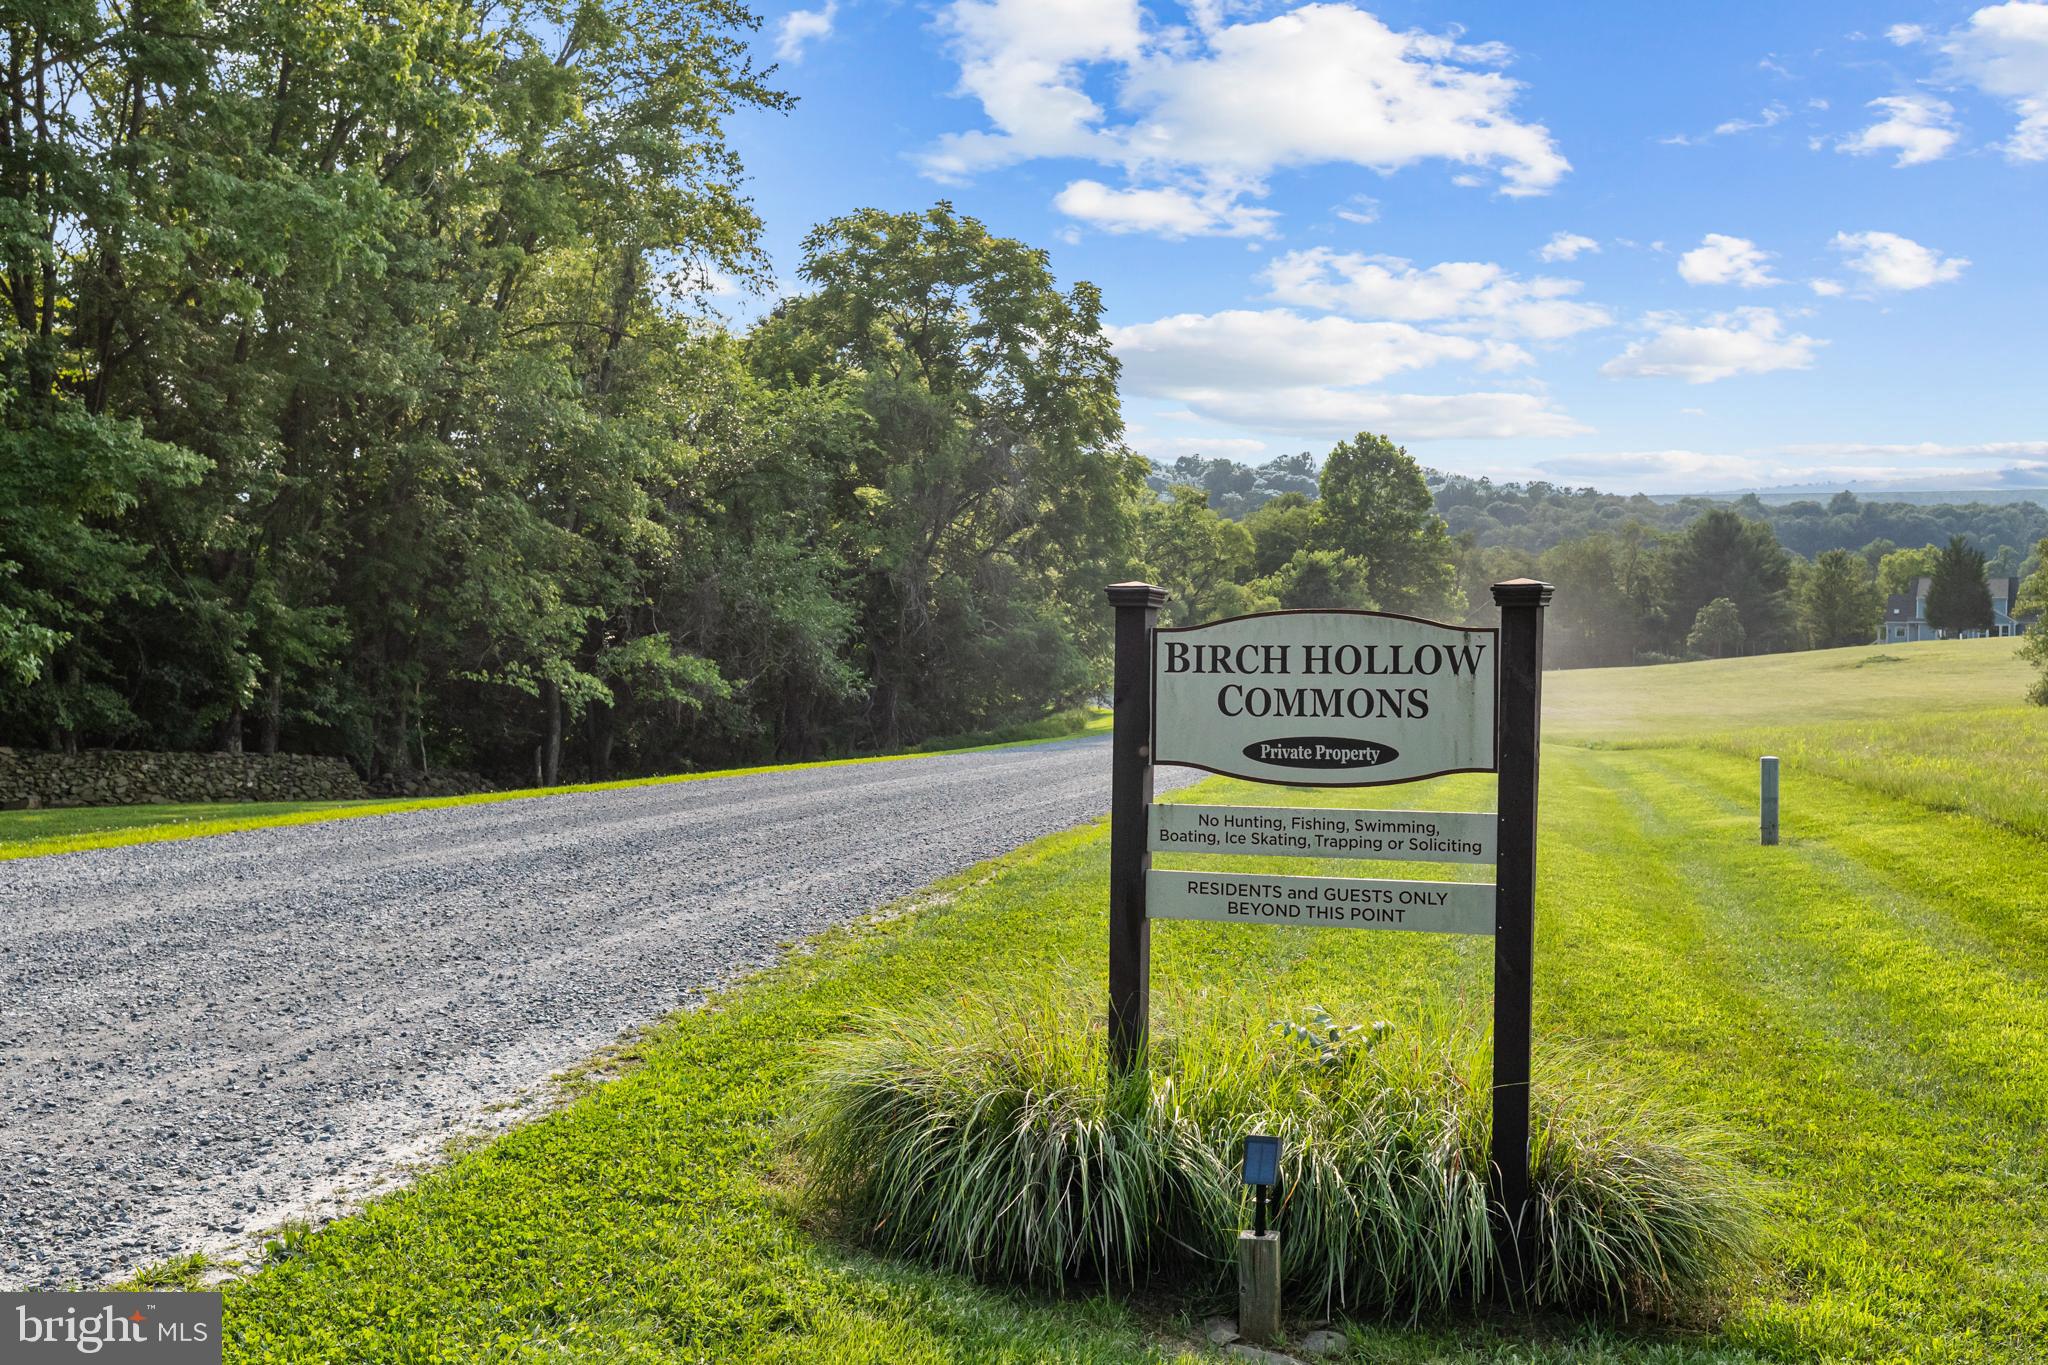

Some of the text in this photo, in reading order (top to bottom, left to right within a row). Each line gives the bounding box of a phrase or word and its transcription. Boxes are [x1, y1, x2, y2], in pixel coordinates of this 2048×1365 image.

[1164, 642, 1486, 676] BIRCH HOLLOW
[1217, 684, 1429, 719] COMMONS
[1260, 744, 1380, 764] Private Property
[1199, 814, 1440, 836] No Hunting, Fishing, Swimming,
[1159, 830, 1482, 855] Boating, Ice Skating, Trapping or Soliciting
[1188, 881, 1448, 906] RESIDENTS and GUESTS ONLY
[1228, 902, 1405, 923] BEYOND THIS POINT
